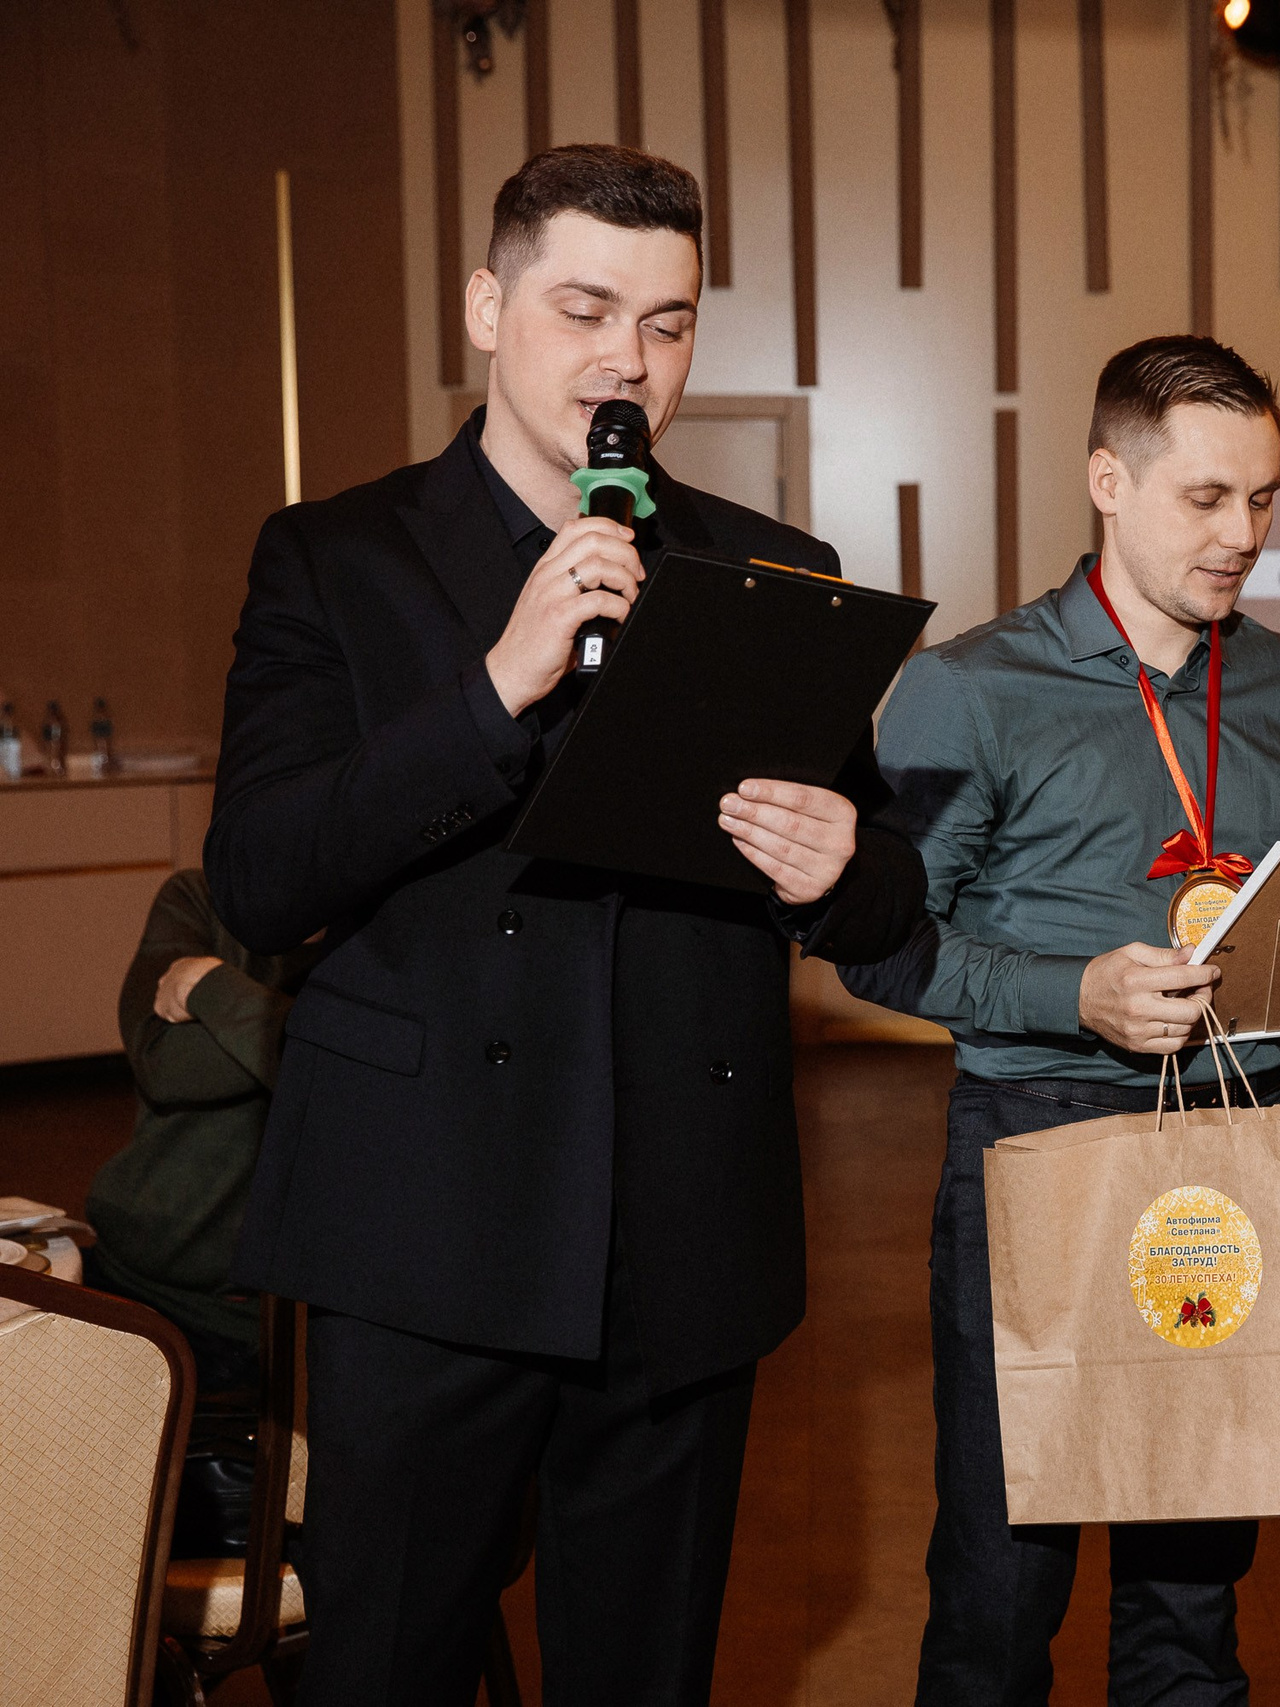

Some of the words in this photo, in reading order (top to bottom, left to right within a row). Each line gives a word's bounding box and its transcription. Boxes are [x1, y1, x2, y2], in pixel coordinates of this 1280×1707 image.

[1166, 1216, 1221, 1225] Автофирма
[1167, 1227, 1221, 1236] «Светлана»
[1149, 1244, 1240, 1256] БЛАГОДАРНОСТЬ
[1172, 1258, 1185, 1267] ЗА
[1186, 1257, 1217, 1267] ТРУД!
[1155, 1275, 1167, 1284] 30
[1169, 1274, 1188, 1284] ЛЕТ
[1190, 1273, 1236, 1283] УСПЕХА!
